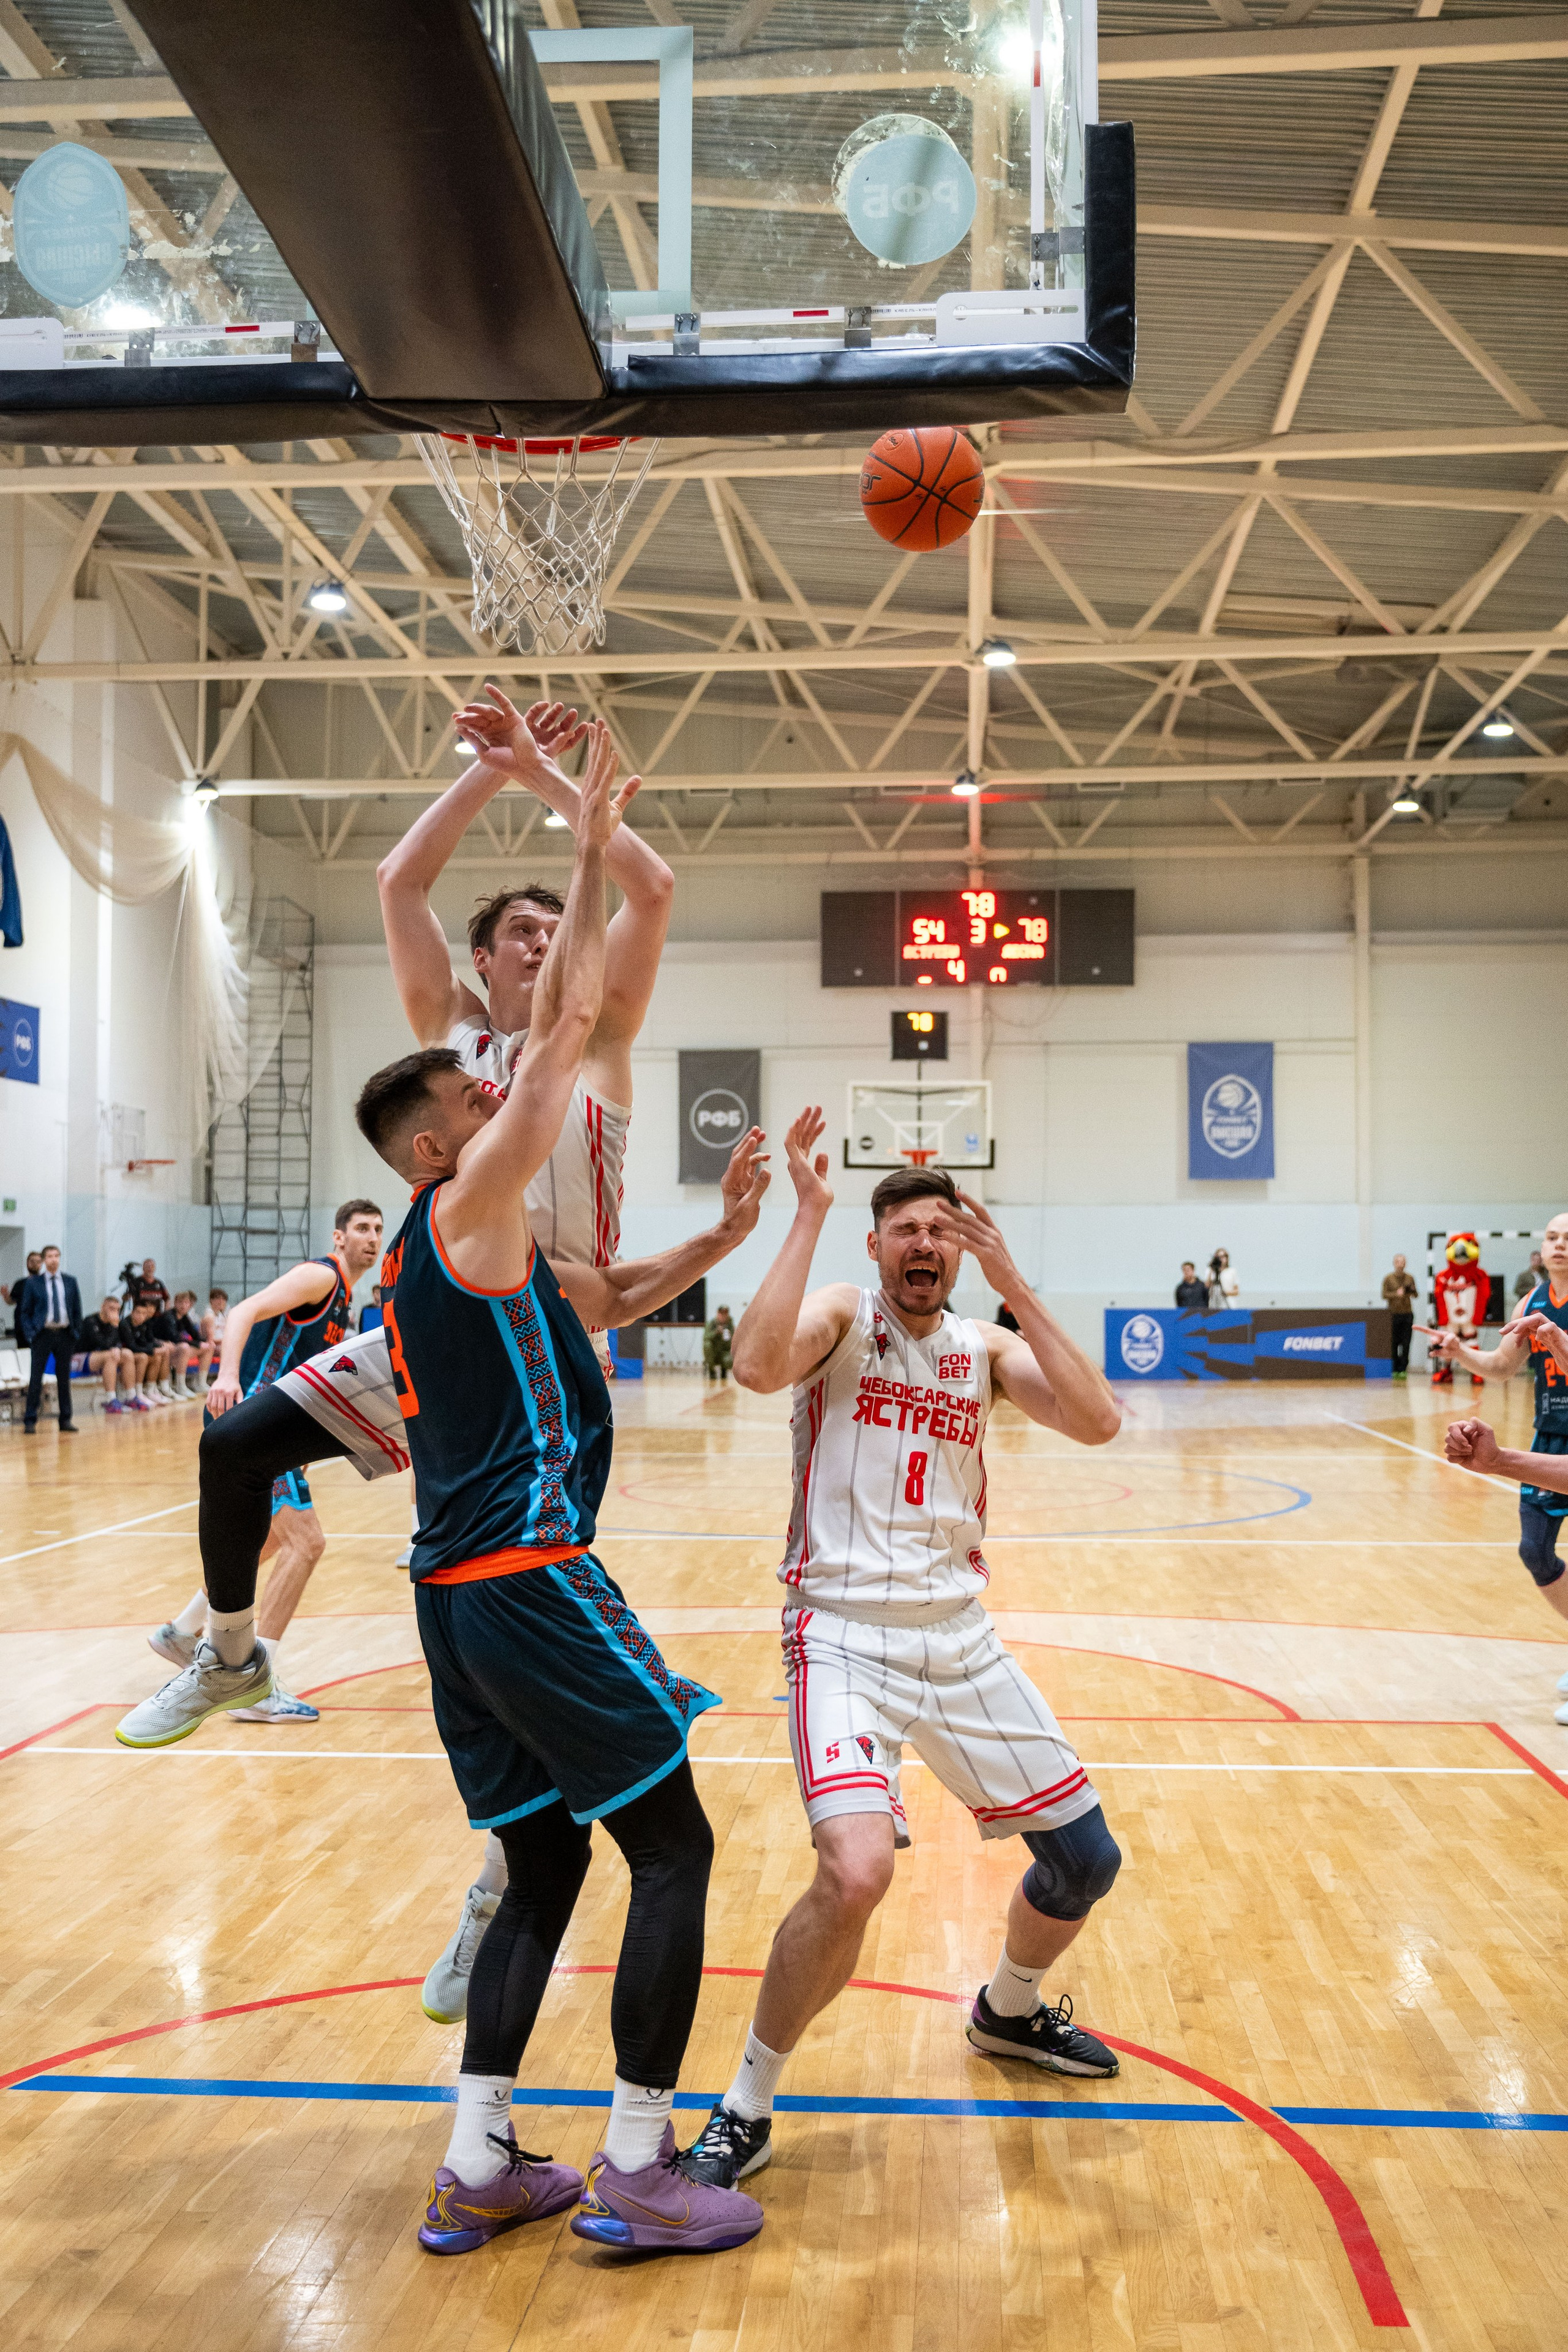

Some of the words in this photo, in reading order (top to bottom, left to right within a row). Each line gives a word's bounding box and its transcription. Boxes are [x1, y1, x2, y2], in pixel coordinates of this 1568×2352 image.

[912, 918, 945, 944] 54
[970, 918, 987, 944] 3
[1017, 917, 1049, 944] 78
[697, 1110, 742, 1128] РФБ
[1283, 1336, 1343, 1351] FONBET
[938, 1353, 971, 1367] FON
[938, 1365, 971, 1379] BET
[859, 1376, 981, 1420] ЧЕБОКСАРСКИЕ
[851, 1394, 979, 1449] ЯСТРЕБЫ
[905, 1450, 927, 1506] 8
